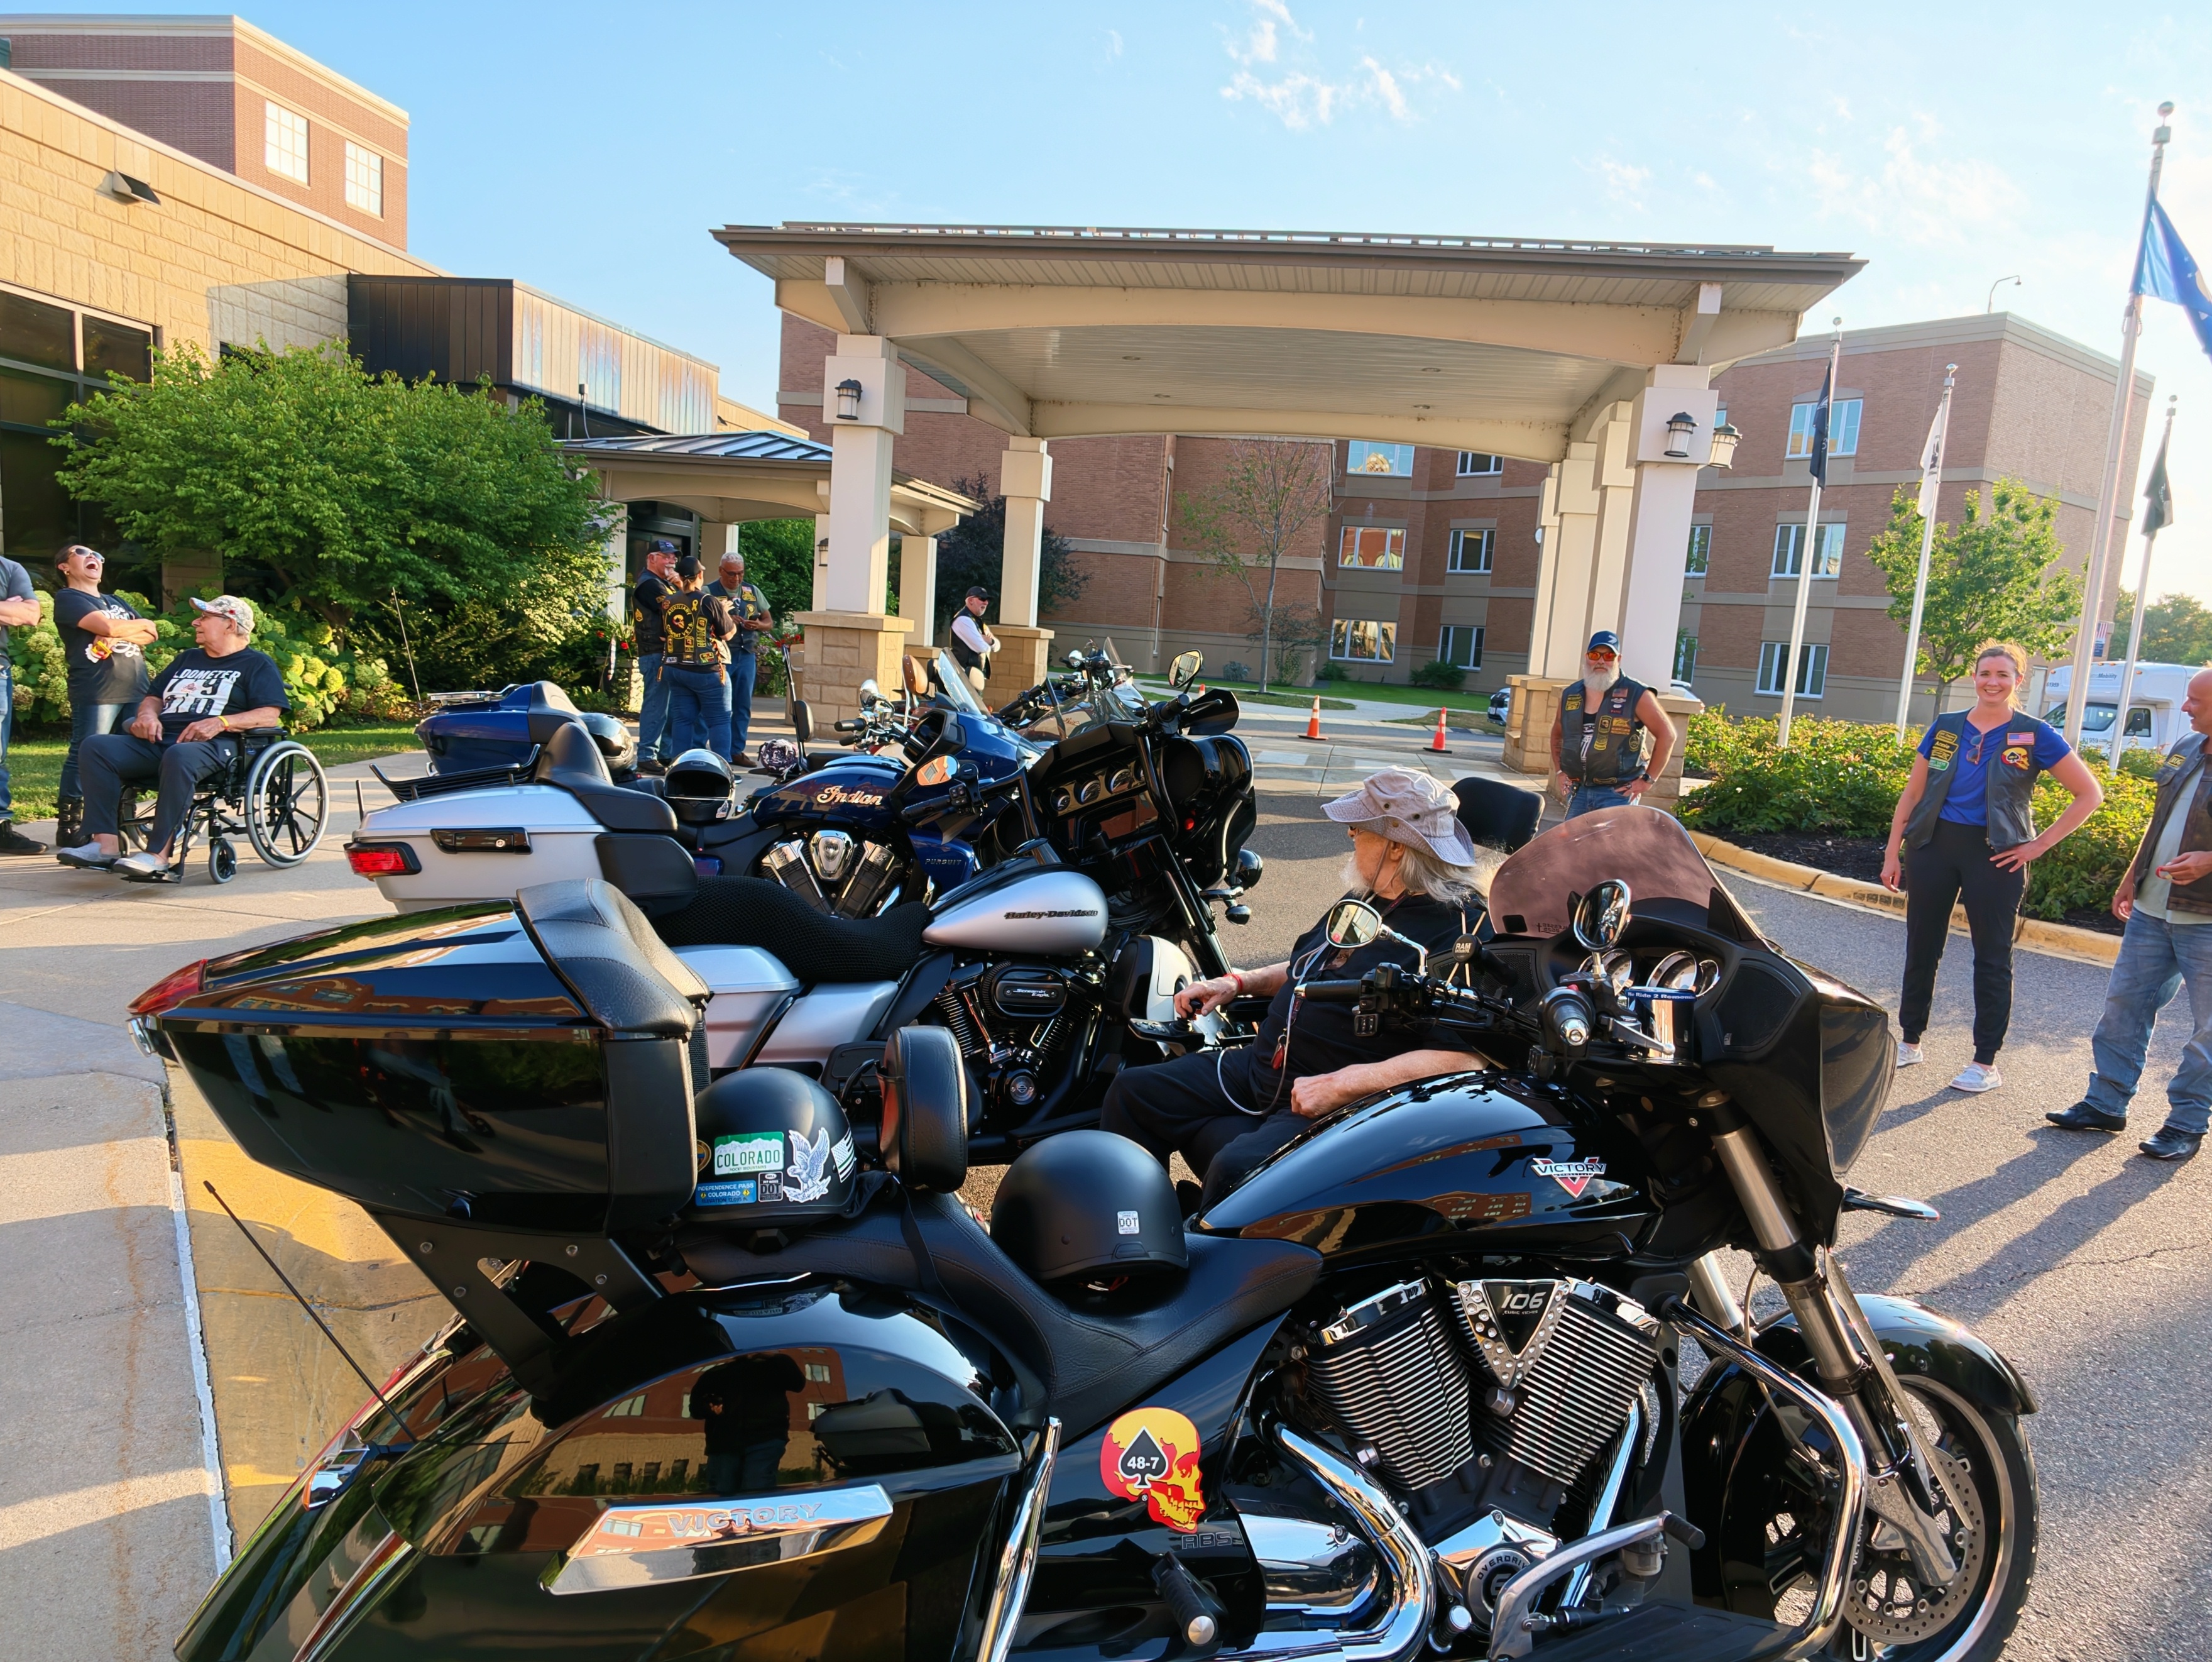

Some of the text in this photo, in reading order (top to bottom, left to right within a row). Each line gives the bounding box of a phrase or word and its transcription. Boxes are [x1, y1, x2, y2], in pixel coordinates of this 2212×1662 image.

[173, 669, 241, 683] LDOMETER
[816, 785, 883, 806] Indian
[1004, 910, 1098, 920] Harley-Davidson
[717, 1150, 780, 1168] COLORADO
[1538, 1164, 1604, 1173] VICTORY
[761, 1184, 781, 1194] DOT
[1119, 1218, 1137, 1227] DOT
[1501, 1292, 1547, 1309] 106
[1127, 1456, 1159, 1469] 48-7
[669, 1503, 822, 1531] VICTORY
[1181, 1531, 1232, 1549] ABS
[1477, 1555, 1528, 1580] OVERDRIV
